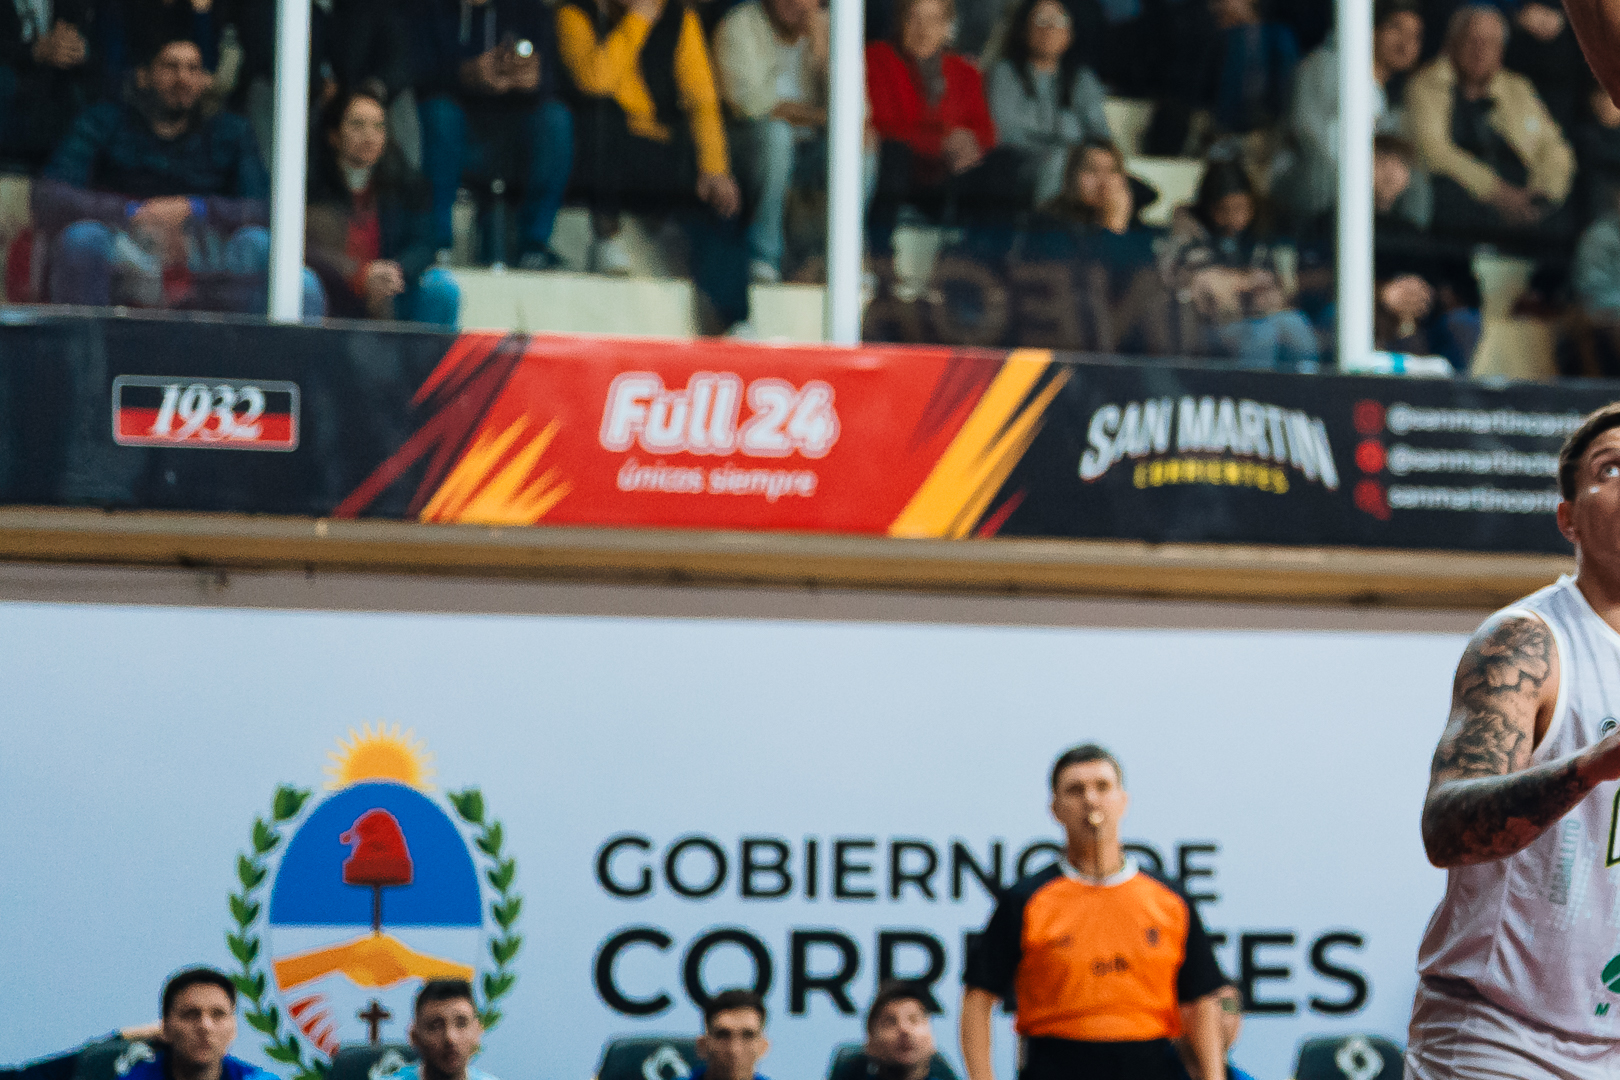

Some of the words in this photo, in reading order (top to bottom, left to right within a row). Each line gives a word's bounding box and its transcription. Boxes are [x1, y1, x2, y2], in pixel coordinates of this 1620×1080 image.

[152, 382, 266, 442] 1932
[1079, 396, 1175, 482] SAN
[1176, 395, 1340, 491] MARTIN
[593, 926, 1370, 1017] CORRES
